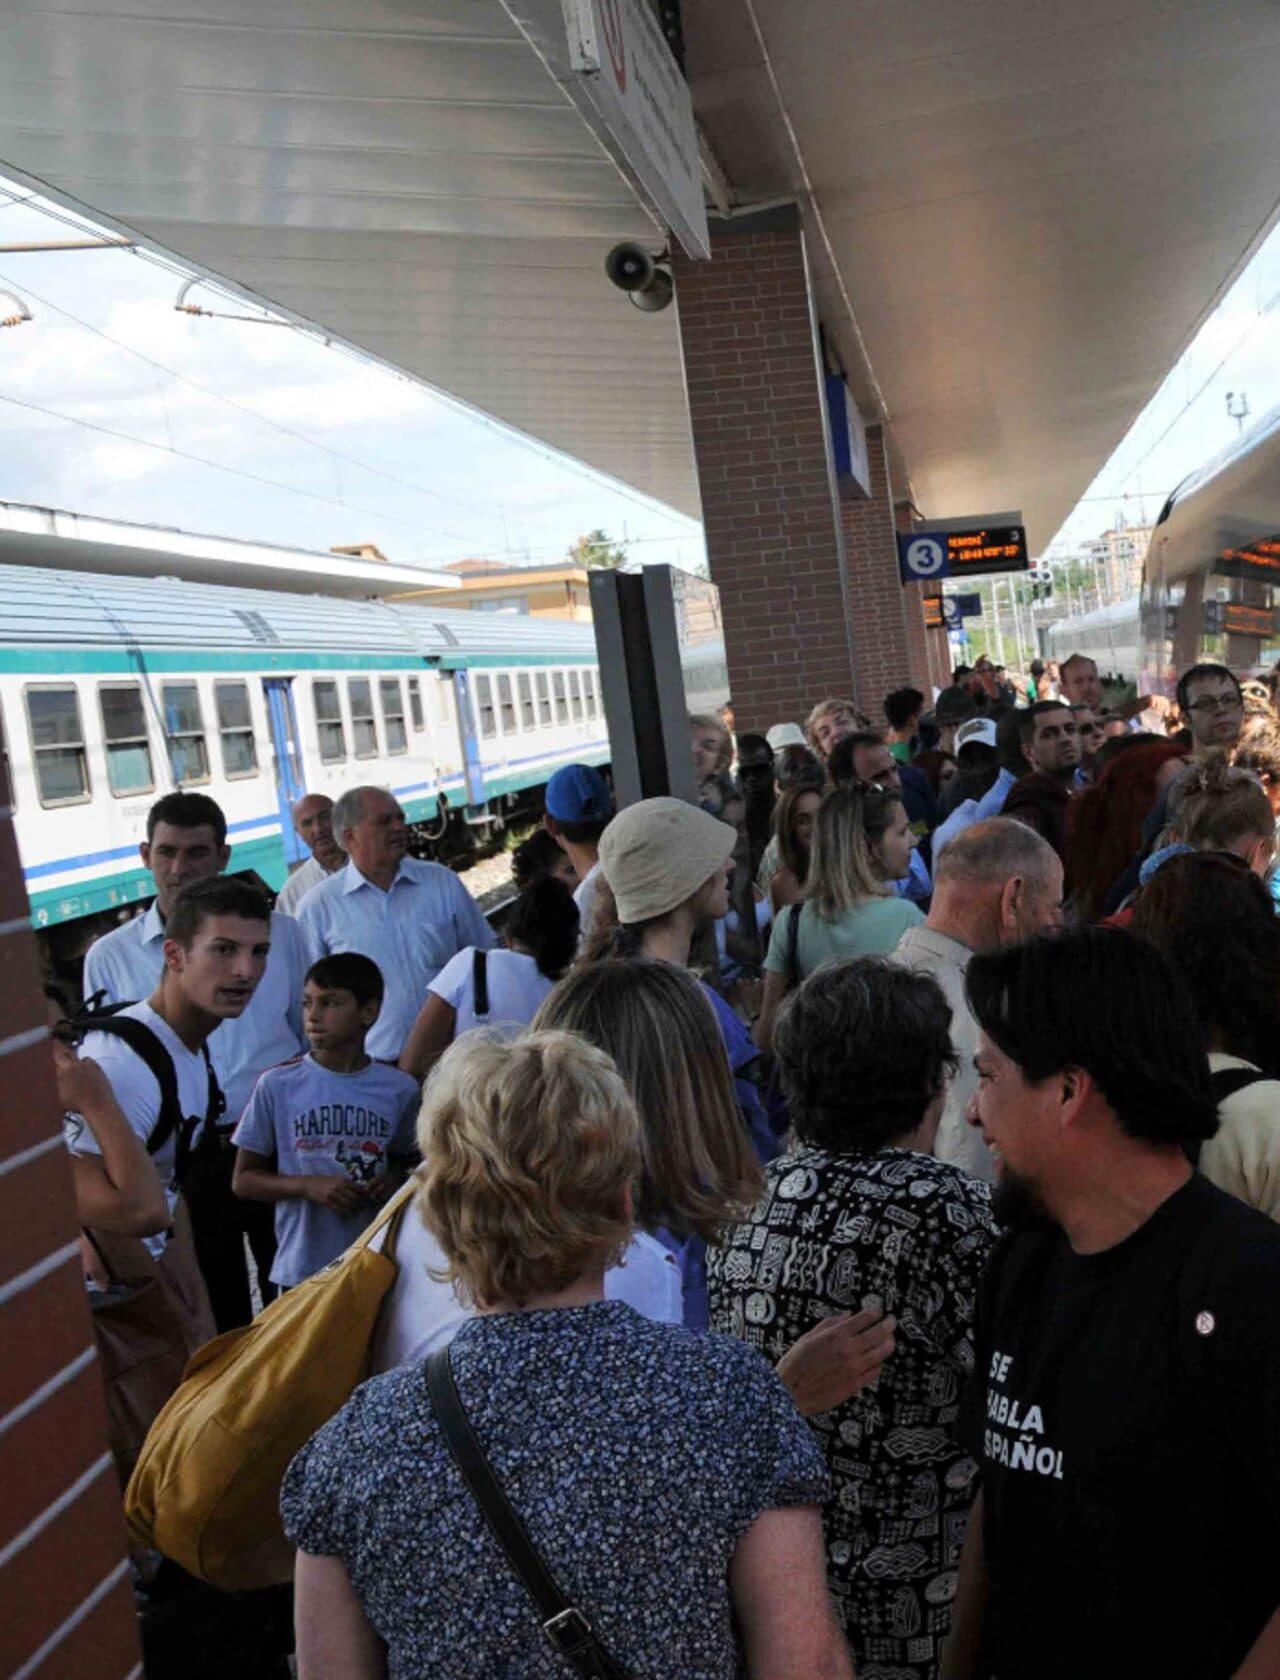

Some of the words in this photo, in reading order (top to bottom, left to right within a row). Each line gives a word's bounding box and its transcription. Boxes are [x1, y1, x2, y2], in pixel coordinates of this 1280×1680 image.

[916, 545, 935, 568] 3
[294, 1104, 391, 1138] HARDCORE
[989, 1351, 1014, 1383] SE
[984, 1428, 1065, 1480] SPAÑOL
